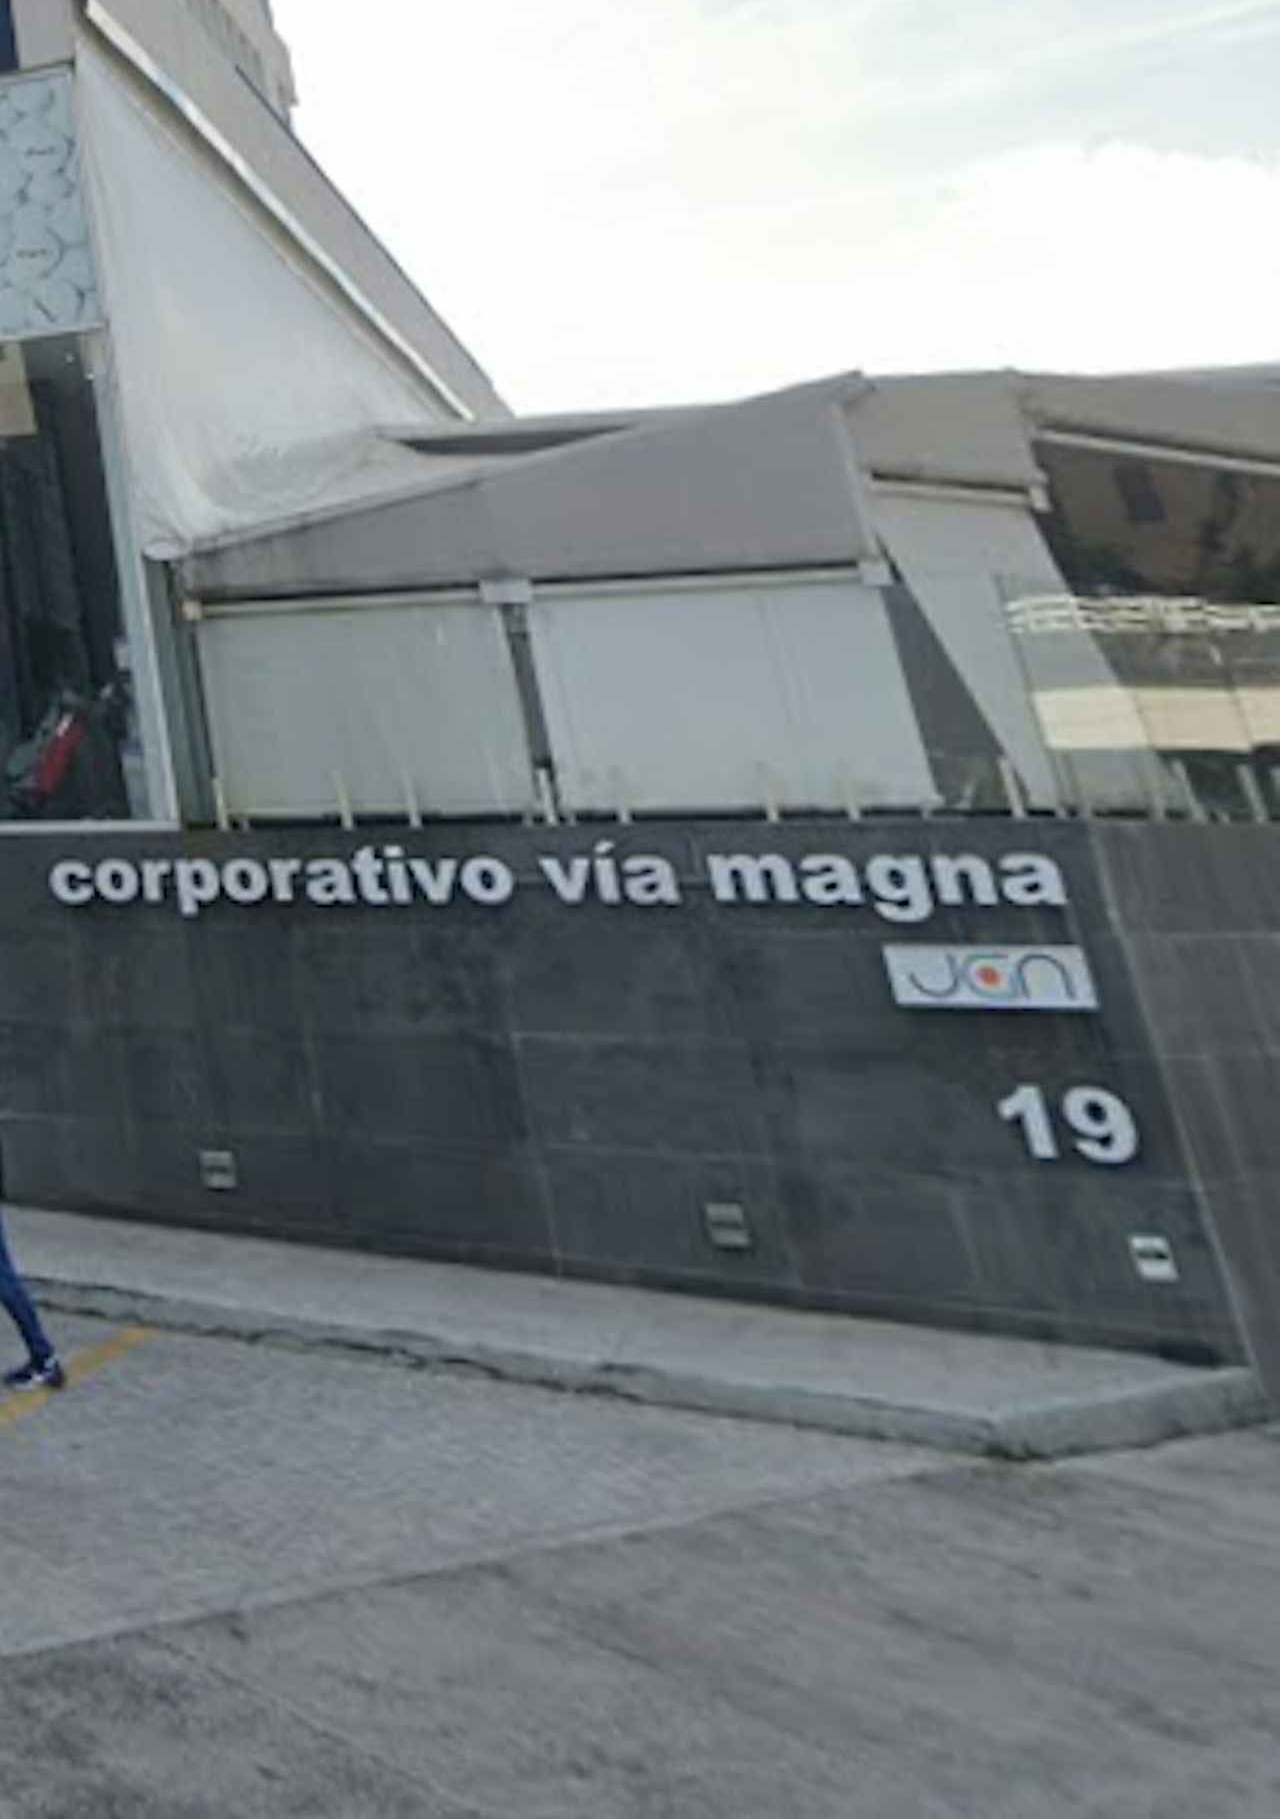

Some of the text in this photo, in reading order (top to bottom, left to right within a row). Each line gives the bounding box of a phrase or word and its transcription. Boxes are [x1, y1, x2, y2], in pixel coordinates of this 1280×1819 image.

[49, 839, 1068, 923] corporativo vía magna
[997, 1085, 1138, 1164] 19
